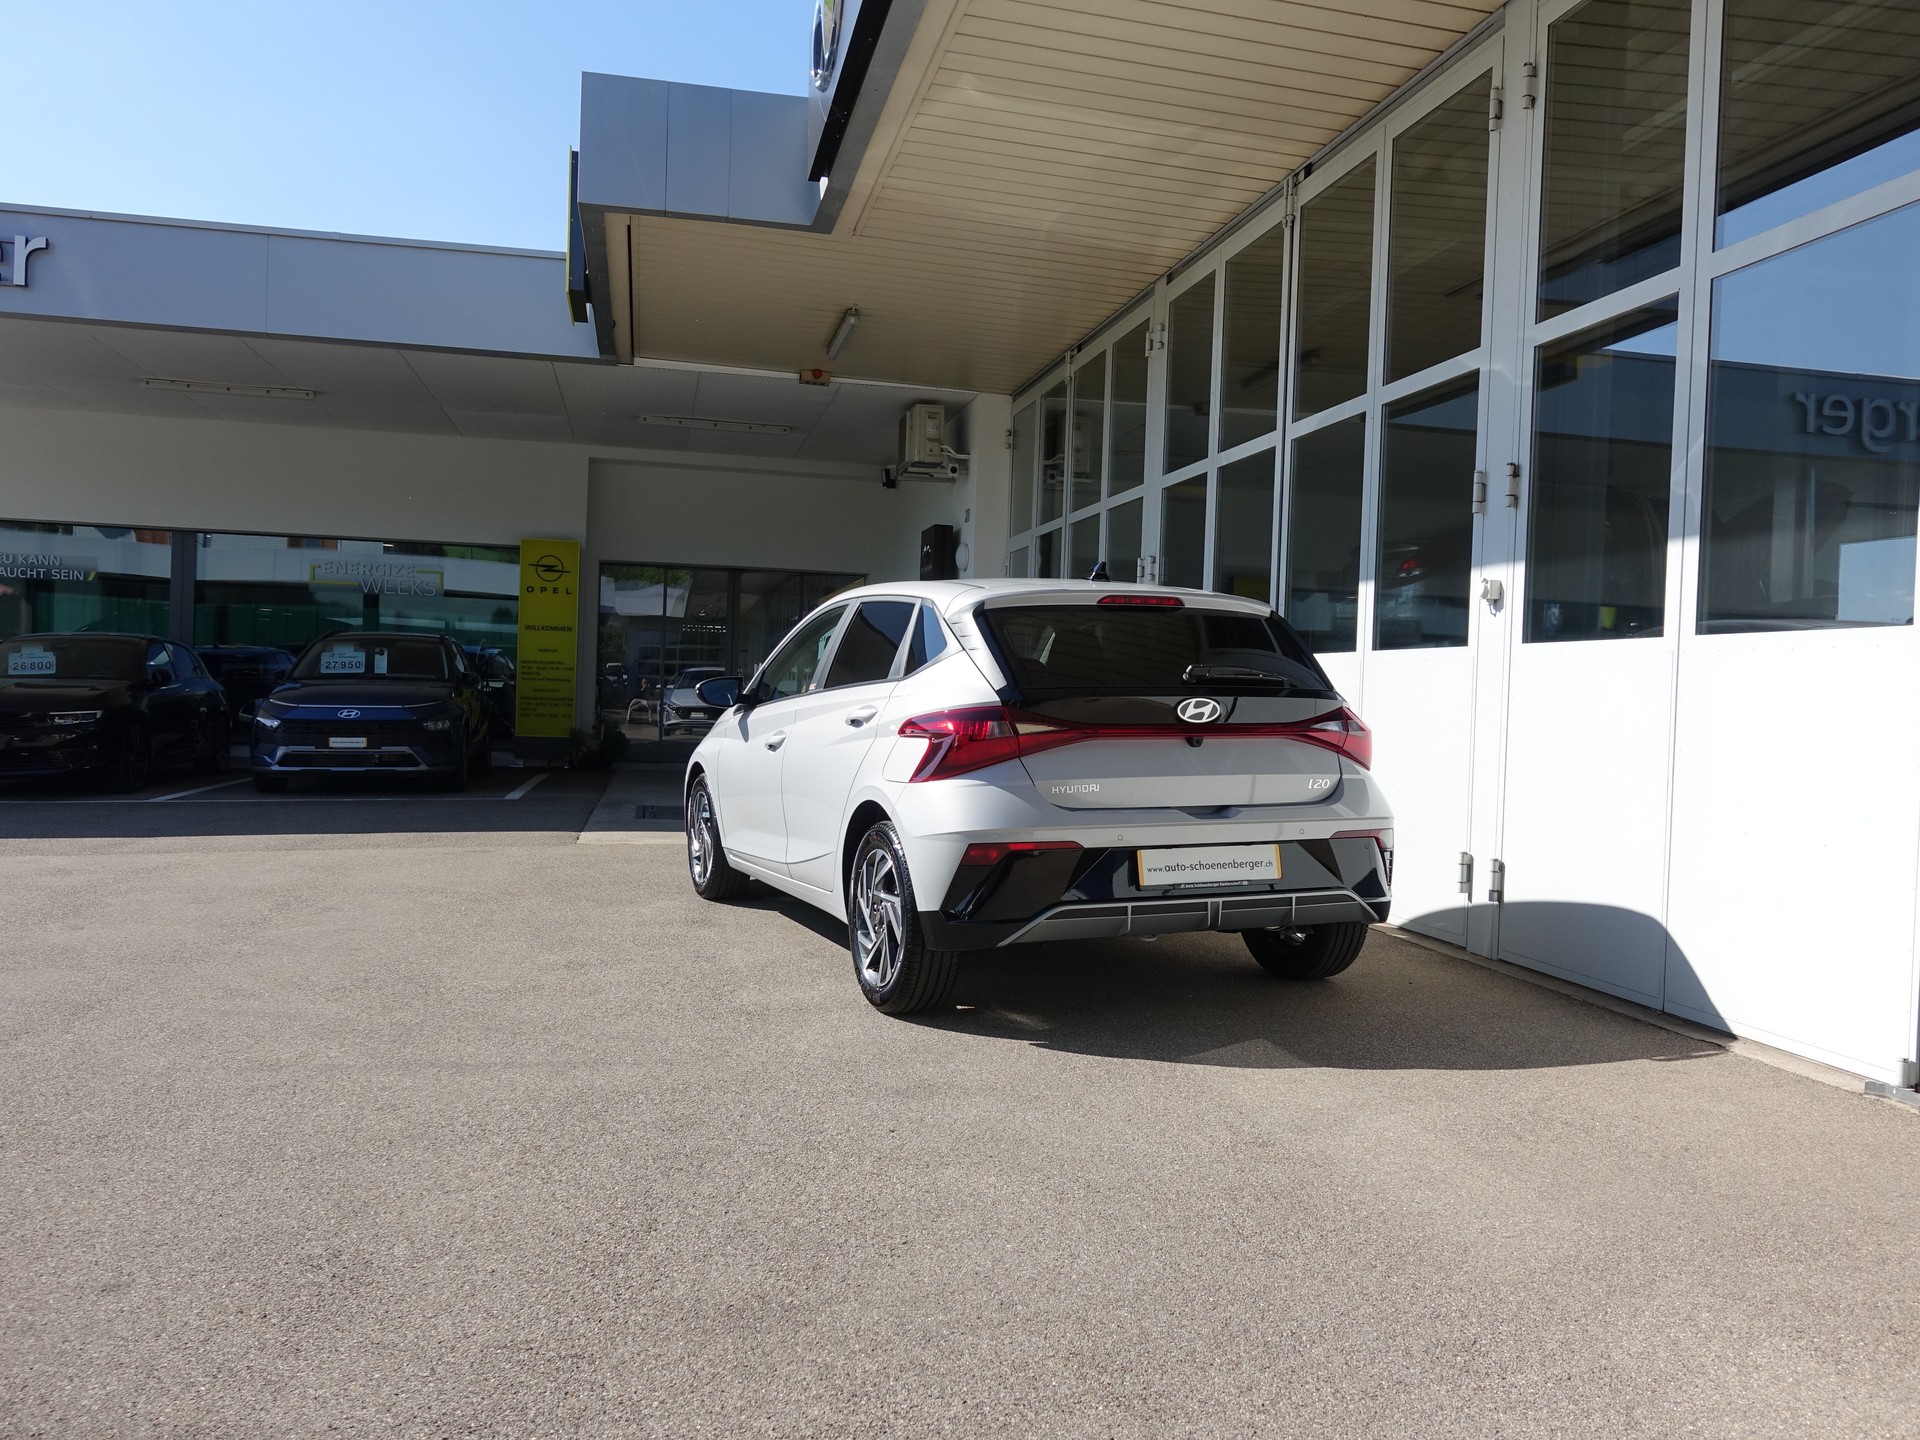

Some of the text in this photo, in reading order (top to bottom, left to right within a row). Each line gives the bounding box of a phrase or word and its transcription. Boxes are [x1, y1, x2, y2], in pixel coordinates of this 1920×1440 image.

[0, 235, 49, 288] r
[18, 554, 60, 566] KANN
[51, 569, 84, 581] SEIN
[324, 560, 416, 578] ENERGIZE
[360, 577, 437, 597] WEEKS
[526, 586, 573, 595] OPEL
[524, 624, 573, 632] WILLKOMMEN
[1052, 784, 1100, 794] HYUNDAI
[1147, 859, 1273, 873] www.auto-schoenenberger.ch
